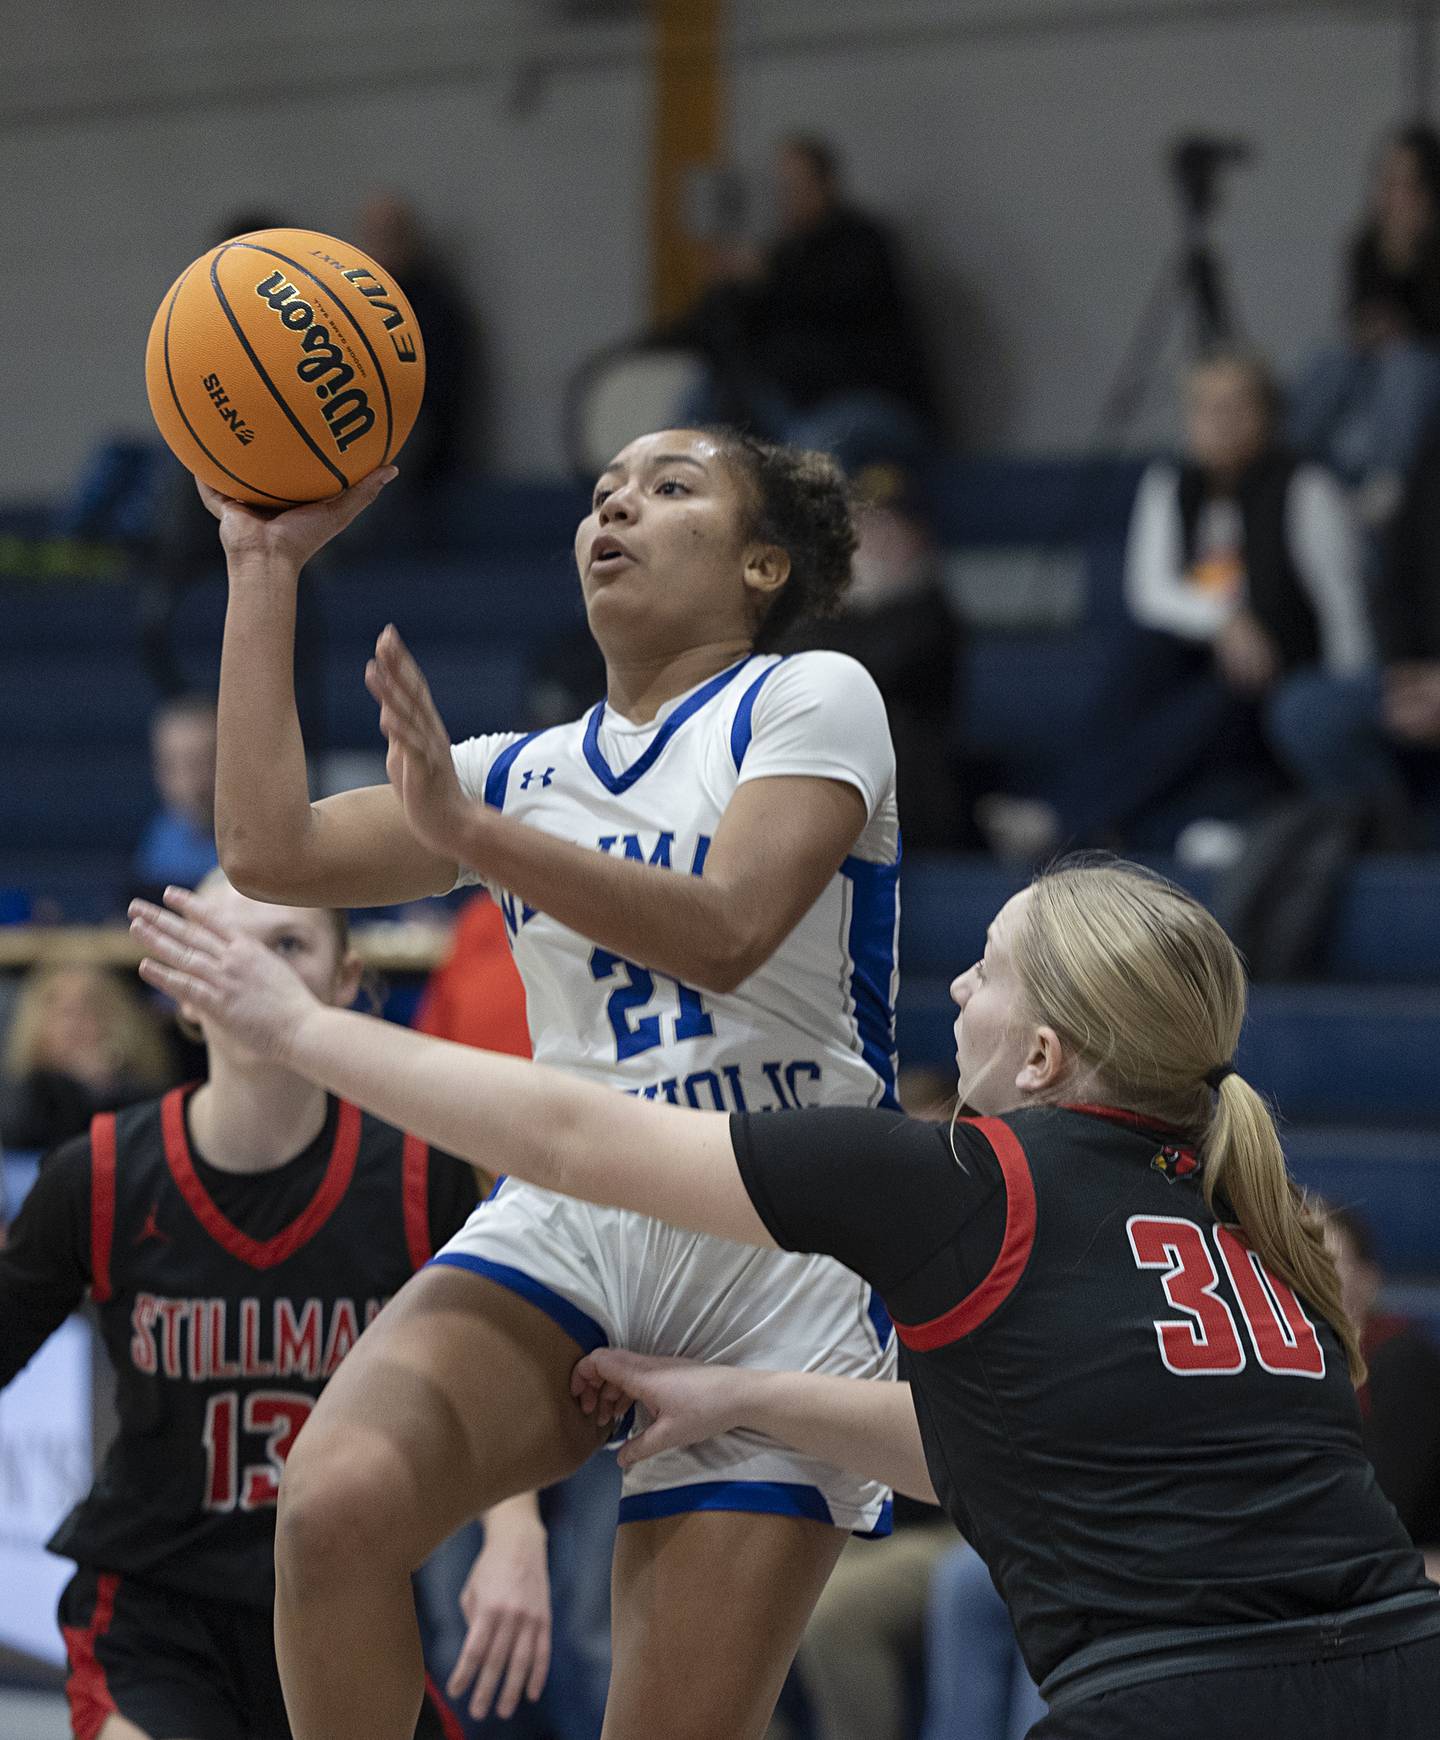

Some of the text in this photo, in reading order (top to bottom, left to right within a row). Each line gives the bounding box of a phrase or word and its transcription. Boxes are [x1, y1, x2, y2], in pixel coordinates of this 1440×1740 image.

[256, 270, 376, 453] Wilson
[310, 251, 417, 363] EVO NXT
[314, 298, 329, 319] BALL
[328, 320, 347, 345] GAME
[202, 373, 246, 433] NFHS
[589, 948, 715, 1062] 21
[131, 1293, 391, 1381] STILLMA
[1126, 1215, 1326, 1379] 30
[203, 1391, 318, 1511] 13
